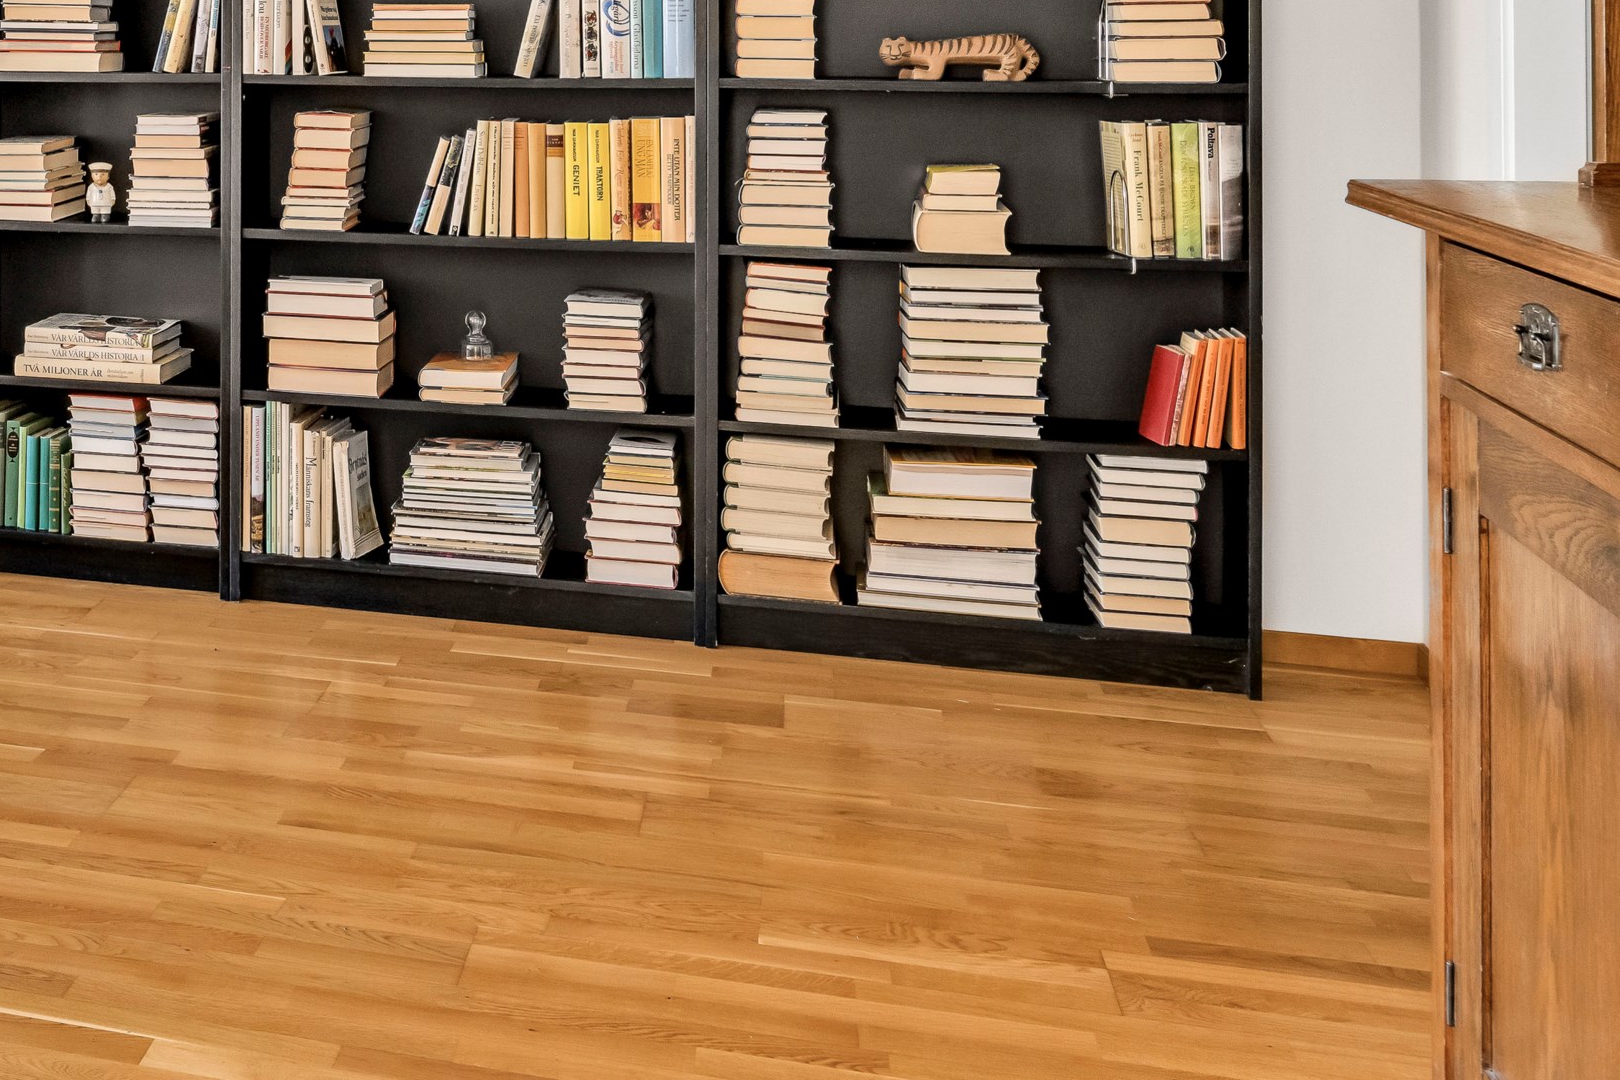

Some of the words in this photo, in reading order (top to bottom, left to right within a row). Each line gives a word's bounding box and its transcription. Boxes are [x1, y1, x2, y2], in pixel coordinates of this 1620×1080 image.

[632, 23, 641, 70] Glasfåglarna
[478, 130, 486, 147] Sven
[636, 139, 645, 157] UNG
[1179, 140, 1188, 156] DEN
[1207, 127, 1216, 159] Poltava
[475, 147, 485, 177] Delblanc
[1133, 149, 1143, 178] Frank
[1188, 166, 1196, 183] DAN
[572, 164, 580, 197] GENIET
[596, 166, 604, 201] TRAKTORN
[1135, 181, 1144, 222] McCourt
[51, 333, 68, 342] VÅR
[51, 349, 68, 357] VÅR
[67, 350, 100, 360] VÄRLDS
[100, 351, 139, 361] HISTORIA
[23, 363, 40, 374] TVÅ
[42, 364, 89, 377] MILJONER
[90, 366, 103, 378] ÅR
[255, 474, 261, 482] ÅR
[305, 456, 318, 499] Människans
[304, 499, 315, 528] framsteg
